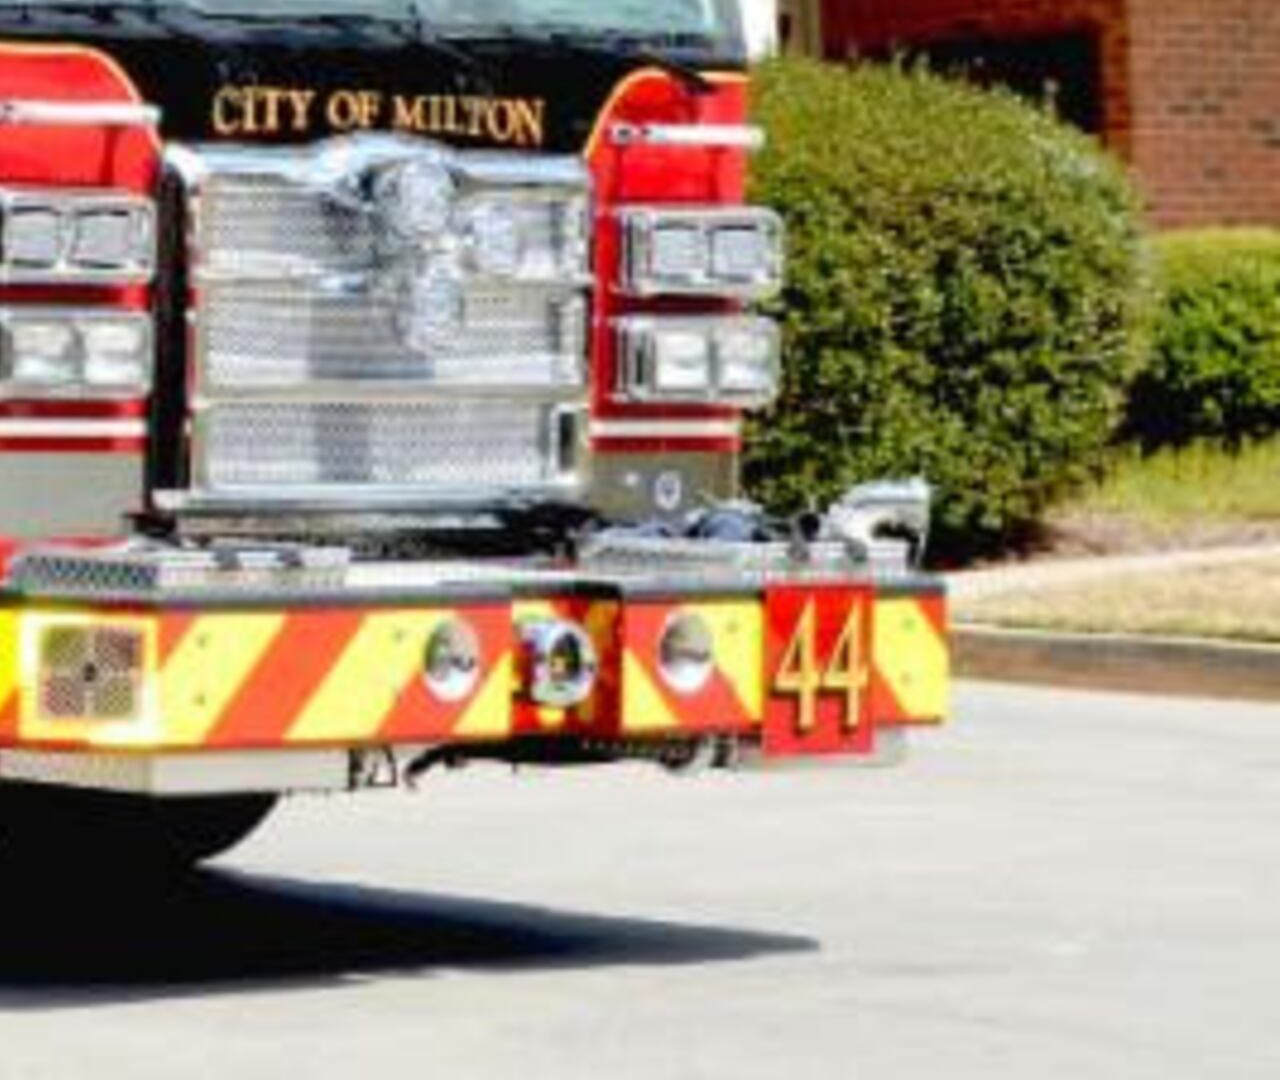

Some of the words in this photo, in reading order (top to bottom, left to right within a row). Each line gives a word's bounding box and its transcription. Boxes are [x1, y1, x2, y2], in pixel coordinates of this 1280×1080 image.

[214, 85, 314, 134] CITY
[326, 89, 382, 128] OF
[393, 95, 546, 146] MILTON
[774, 590, 869, 732] 44
